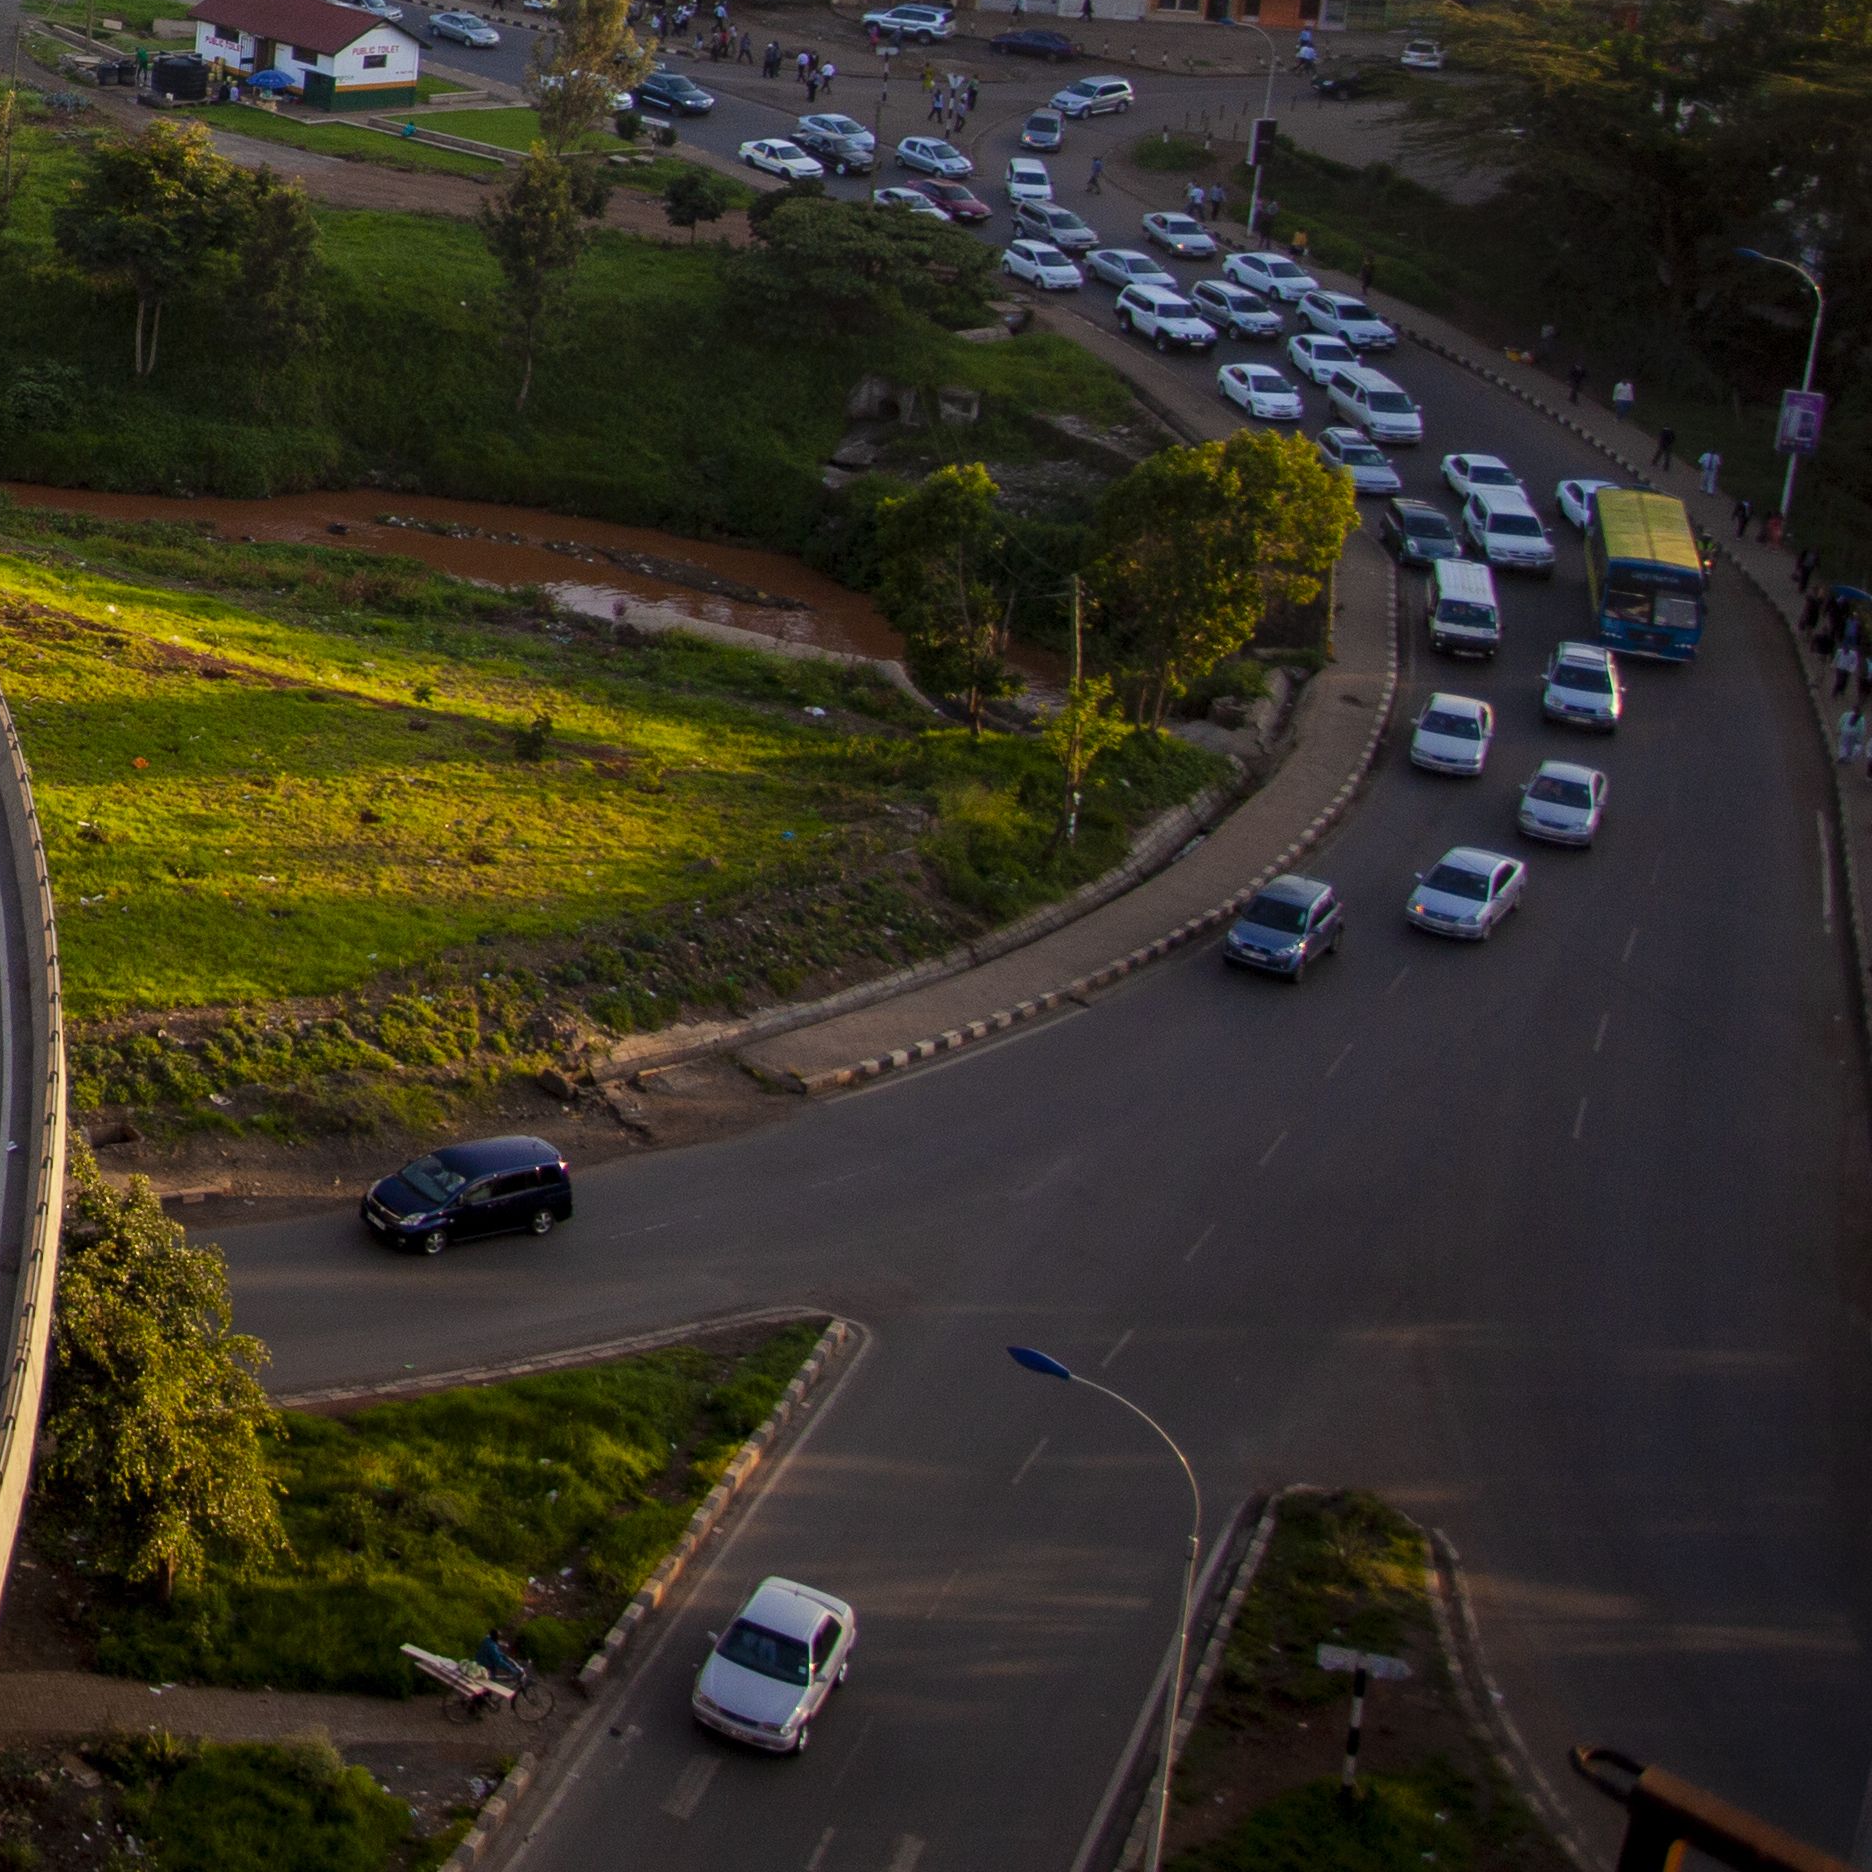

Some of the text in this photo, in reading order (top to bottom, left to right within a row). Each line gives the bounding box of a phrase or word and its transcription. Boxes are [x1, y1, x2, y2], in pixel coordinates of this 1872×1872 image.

[206, 35, 224, 48] PUBLIC
[352, 45, 400, 57] PUBLIC TOILET
